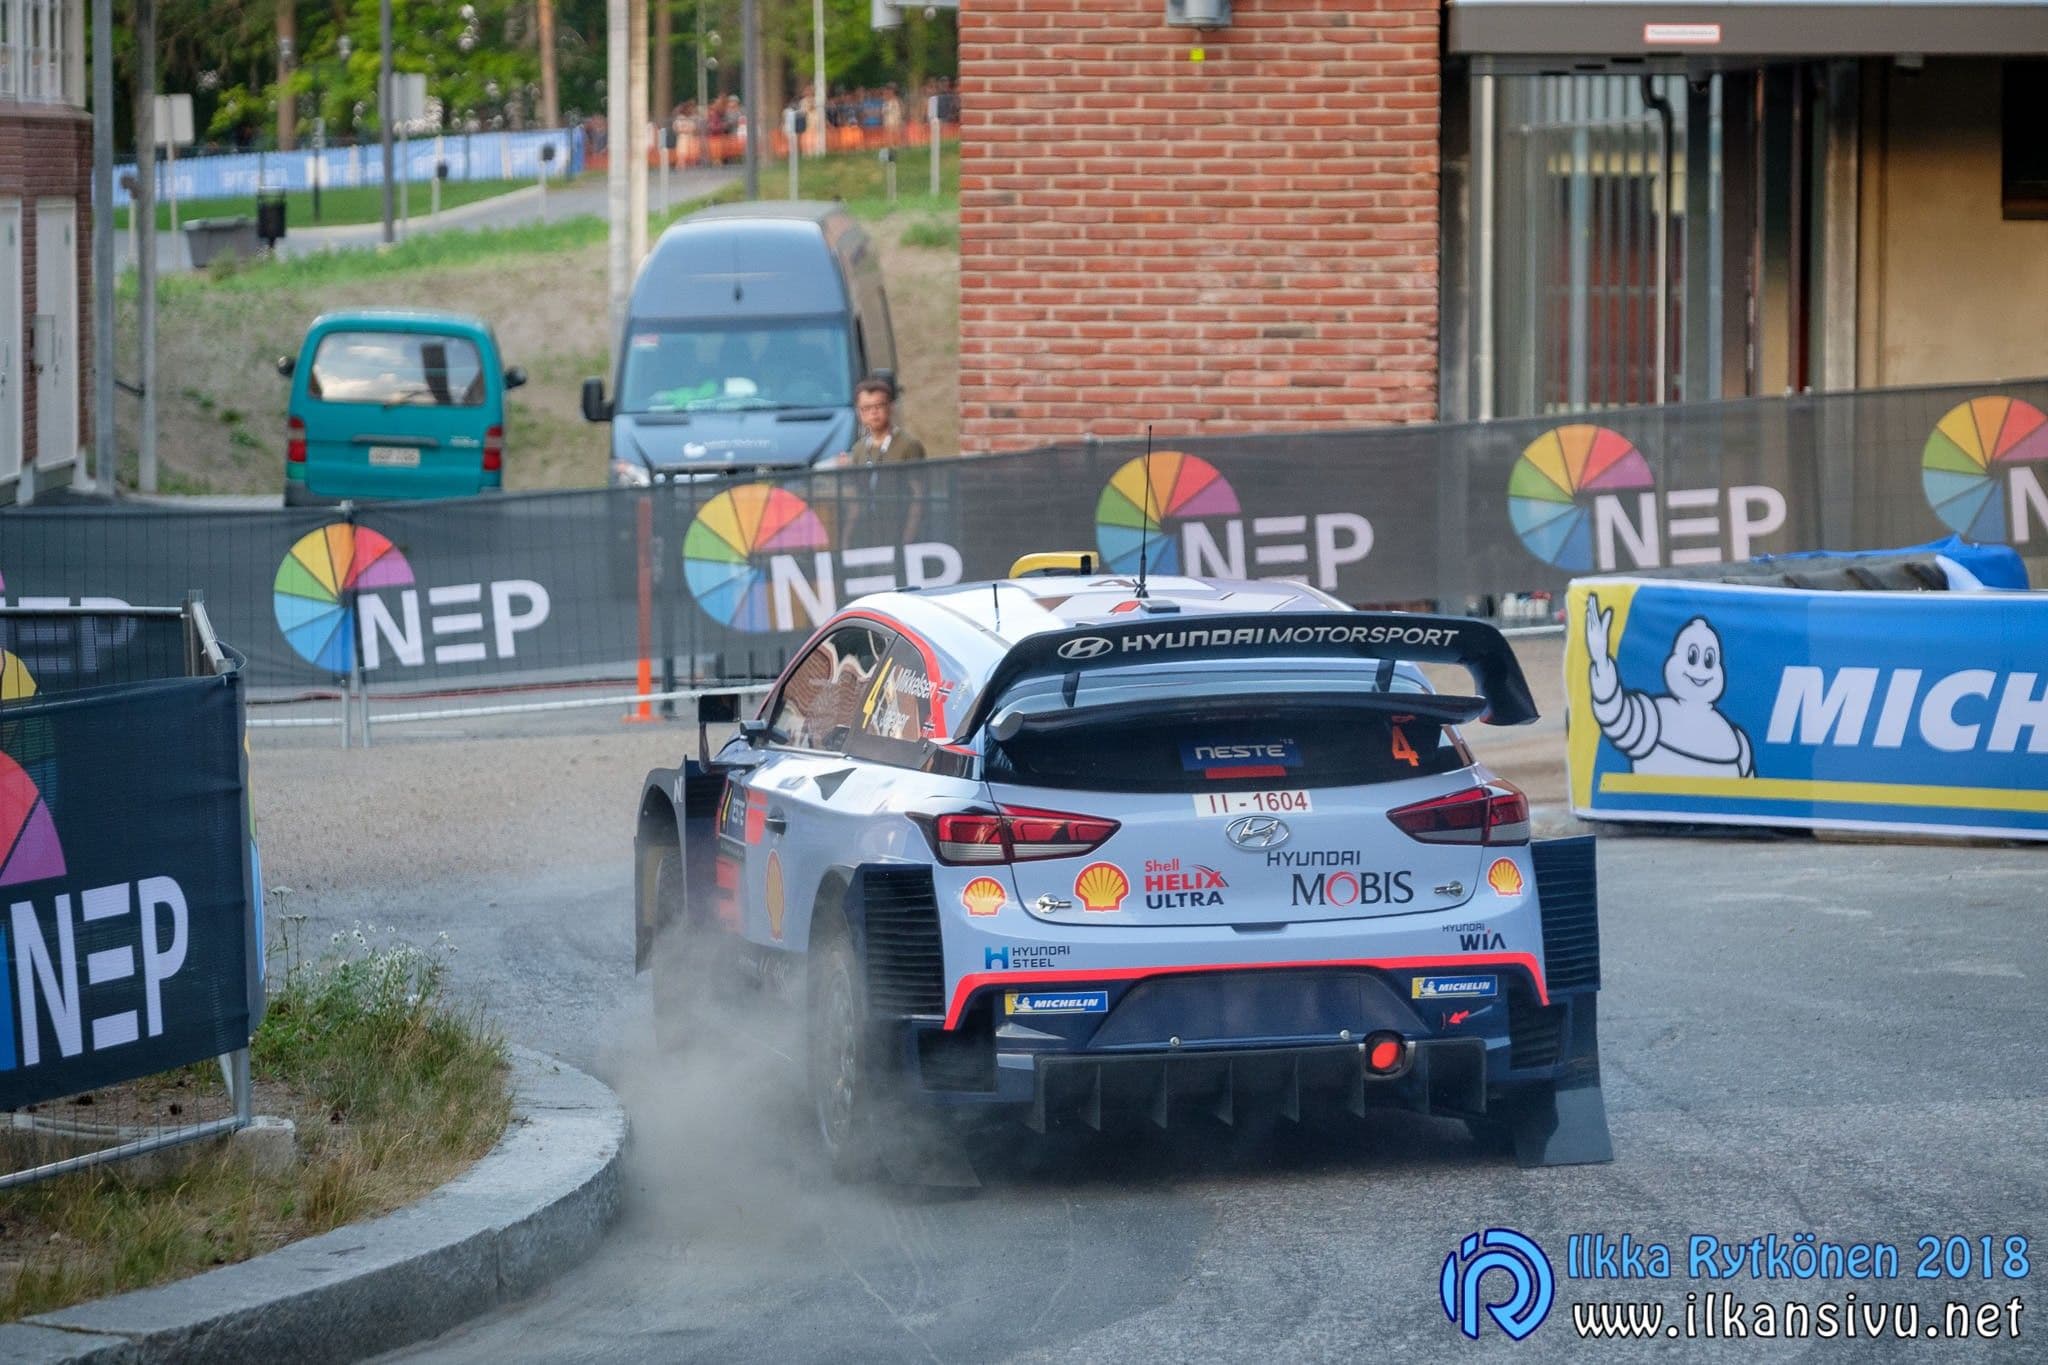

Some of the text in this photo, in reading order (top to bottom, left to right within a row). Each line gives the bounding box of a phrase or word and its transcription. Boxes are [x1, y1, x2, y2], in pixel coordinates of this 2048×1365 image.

[1594, 485, 1787, 570] NEP
[1181, 513, 1375, 591] NEP
[769, 542, 964, 631] NEP
[358, 579, 551, 670] NEP
[1121, 626, 1459, 653] HYUNDAI MOTORSPORT
[1194, 744, 1286, 760] NESTE
[1391, 724, 1420, 767] 4
[1145, 858, 1180, 873] Shell
[1267, 850, 1361, 867] HYUNDAI
[1145, 870, 1227, 892] HELIX
[1292, 870, 1414, 907] MOBIS
[1146, 890, 1225, 909] ULTRA
[1442, 923, 1485, 933] HYUNDAI
[1012, 945, 1071, 957] HYUNDAI
[1460, 929, 1507, 951] WIA
[10, 875, 189, 1067] NEP
[1012, 958, 1055, 968] STEEL
[1438, 981, 1490, 992] MICHELIN
[1034, 997, 1099, 1008] MICHELIN
